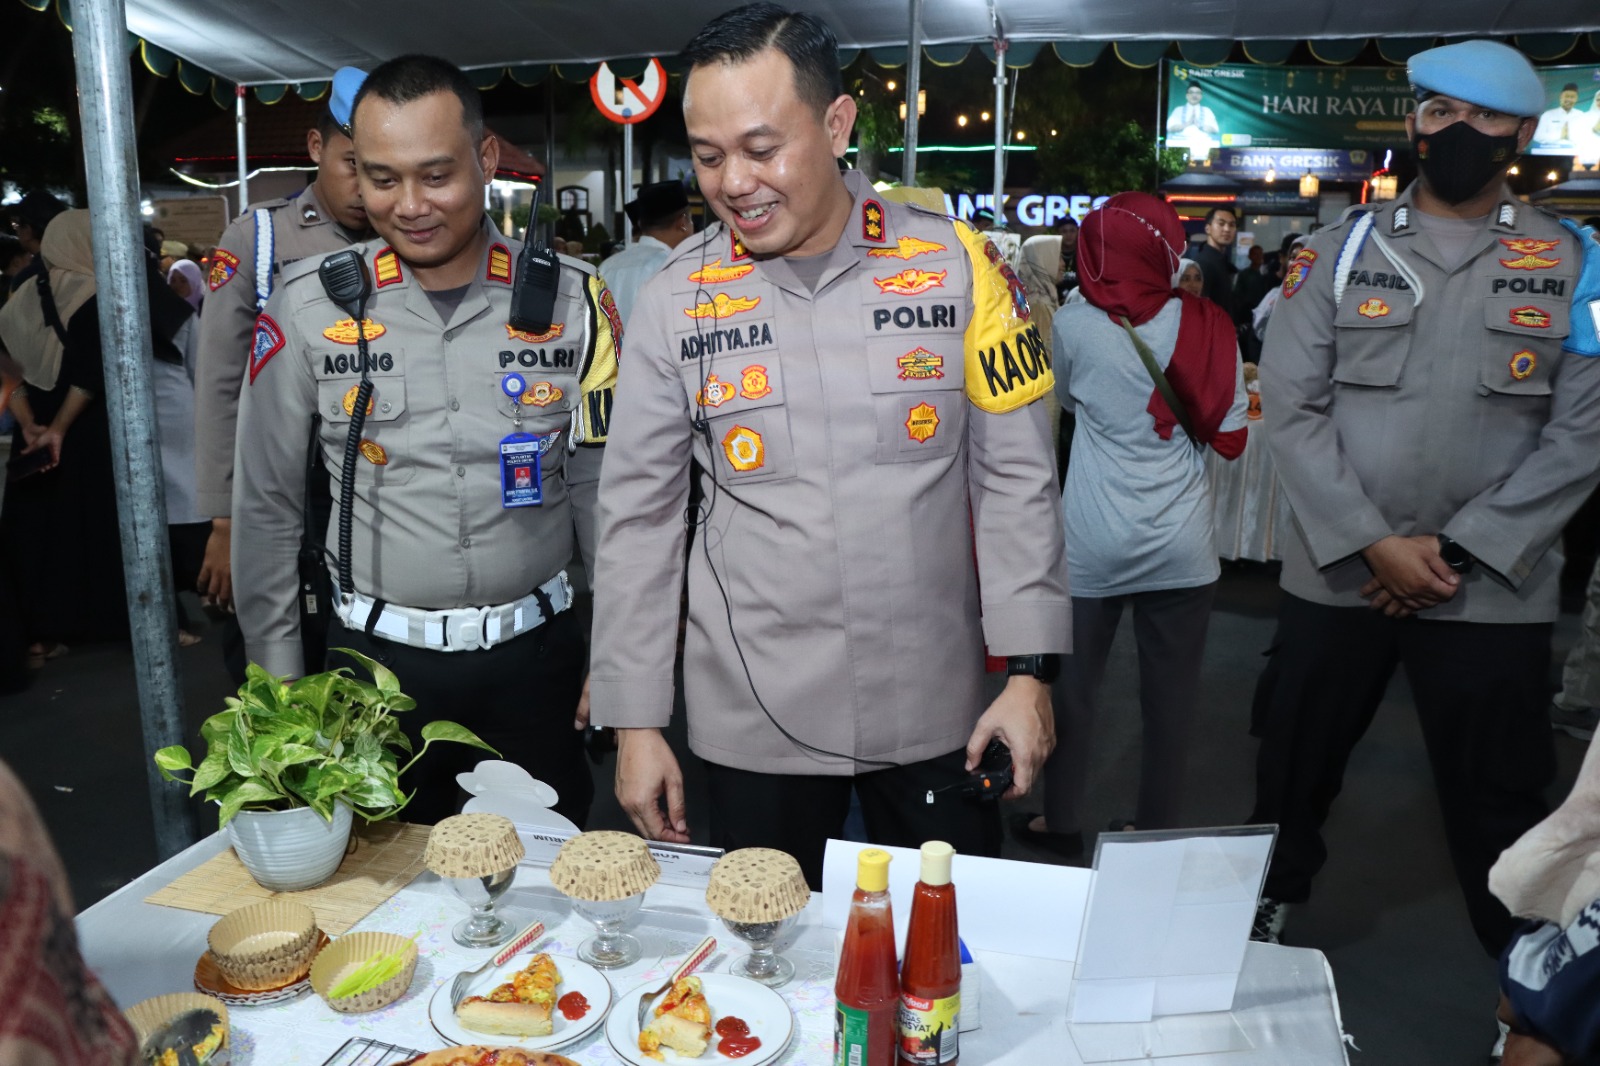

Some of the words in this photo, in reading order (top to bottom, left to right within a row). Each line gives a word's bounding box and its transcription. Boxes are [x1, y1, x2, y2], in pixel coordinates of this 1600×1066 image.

[1262, 95, 1318, 114] HARI
[1326, 96, 1386, 116] RAYA
[1230, 155, 1277, 167] BANK
[1280, 156, 1340, 168] GRESIK
[1347, 269, 1411, 291] FARID
[1492, 278, 1565, 297] POLRI
[873, 304, 956, 331] POLRI
[681, 322, 773, 361] ADHITYA.P.A
[324, 352, 394, 375] AGUNG
[498, 348, 575, 369] POLRI
